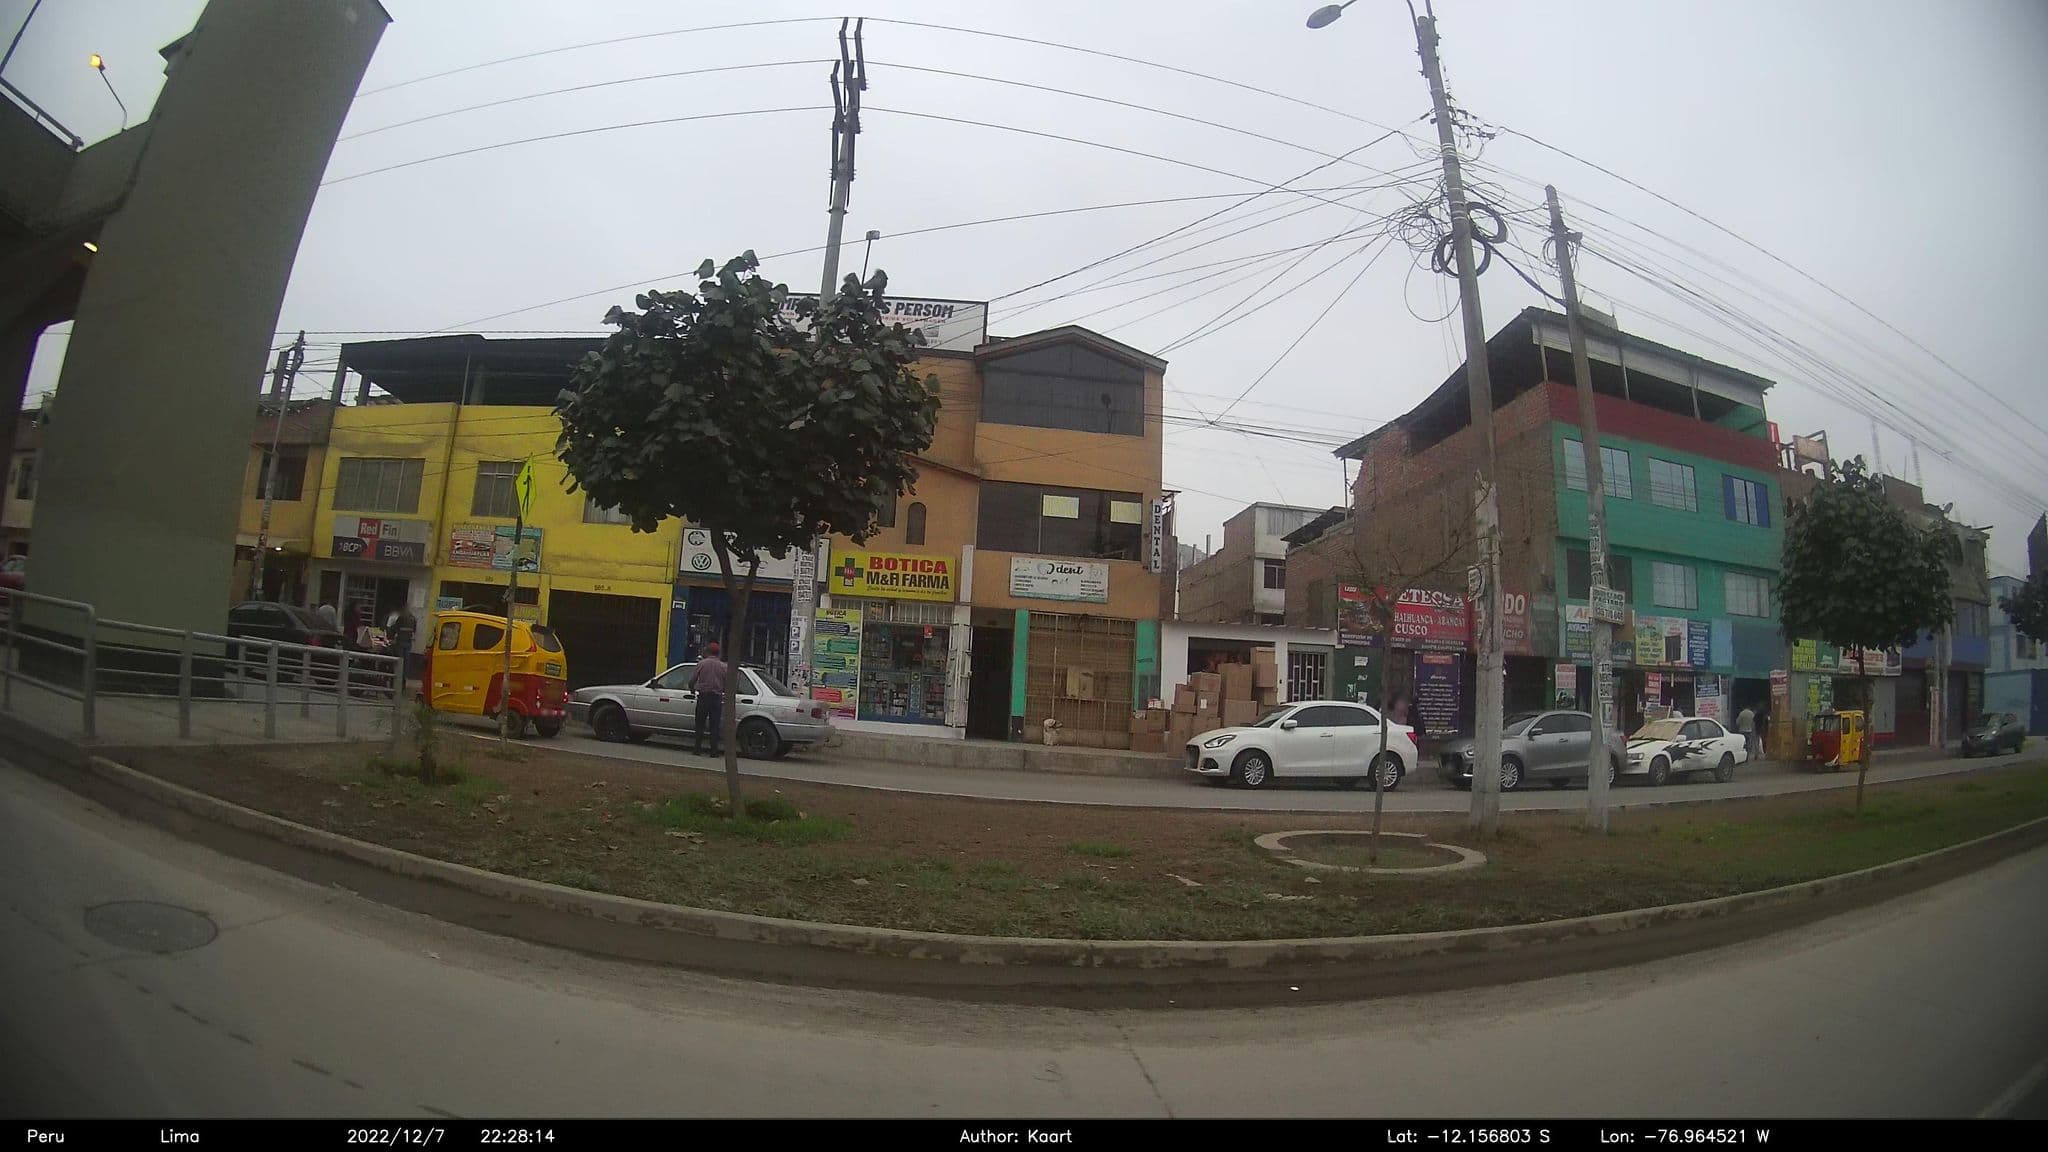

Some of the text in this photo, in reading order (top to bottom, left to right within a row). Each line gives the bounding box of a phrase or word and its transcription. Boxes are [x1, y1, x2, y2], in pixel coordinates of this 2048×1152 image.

[895, 302, 954, 318] PERSOM
[360, 522, 398, 537] Red Fin
[1152, 504, 1161, 570] DENTAL
[342, 542, 359, 553] BCP
[384, 545, 414, 558] BBVA
[869, 556, 948, 574] BOTICA
[902, 573, 950, 589] FARMA
[1395, 624, 1428, 636] CUSCO
